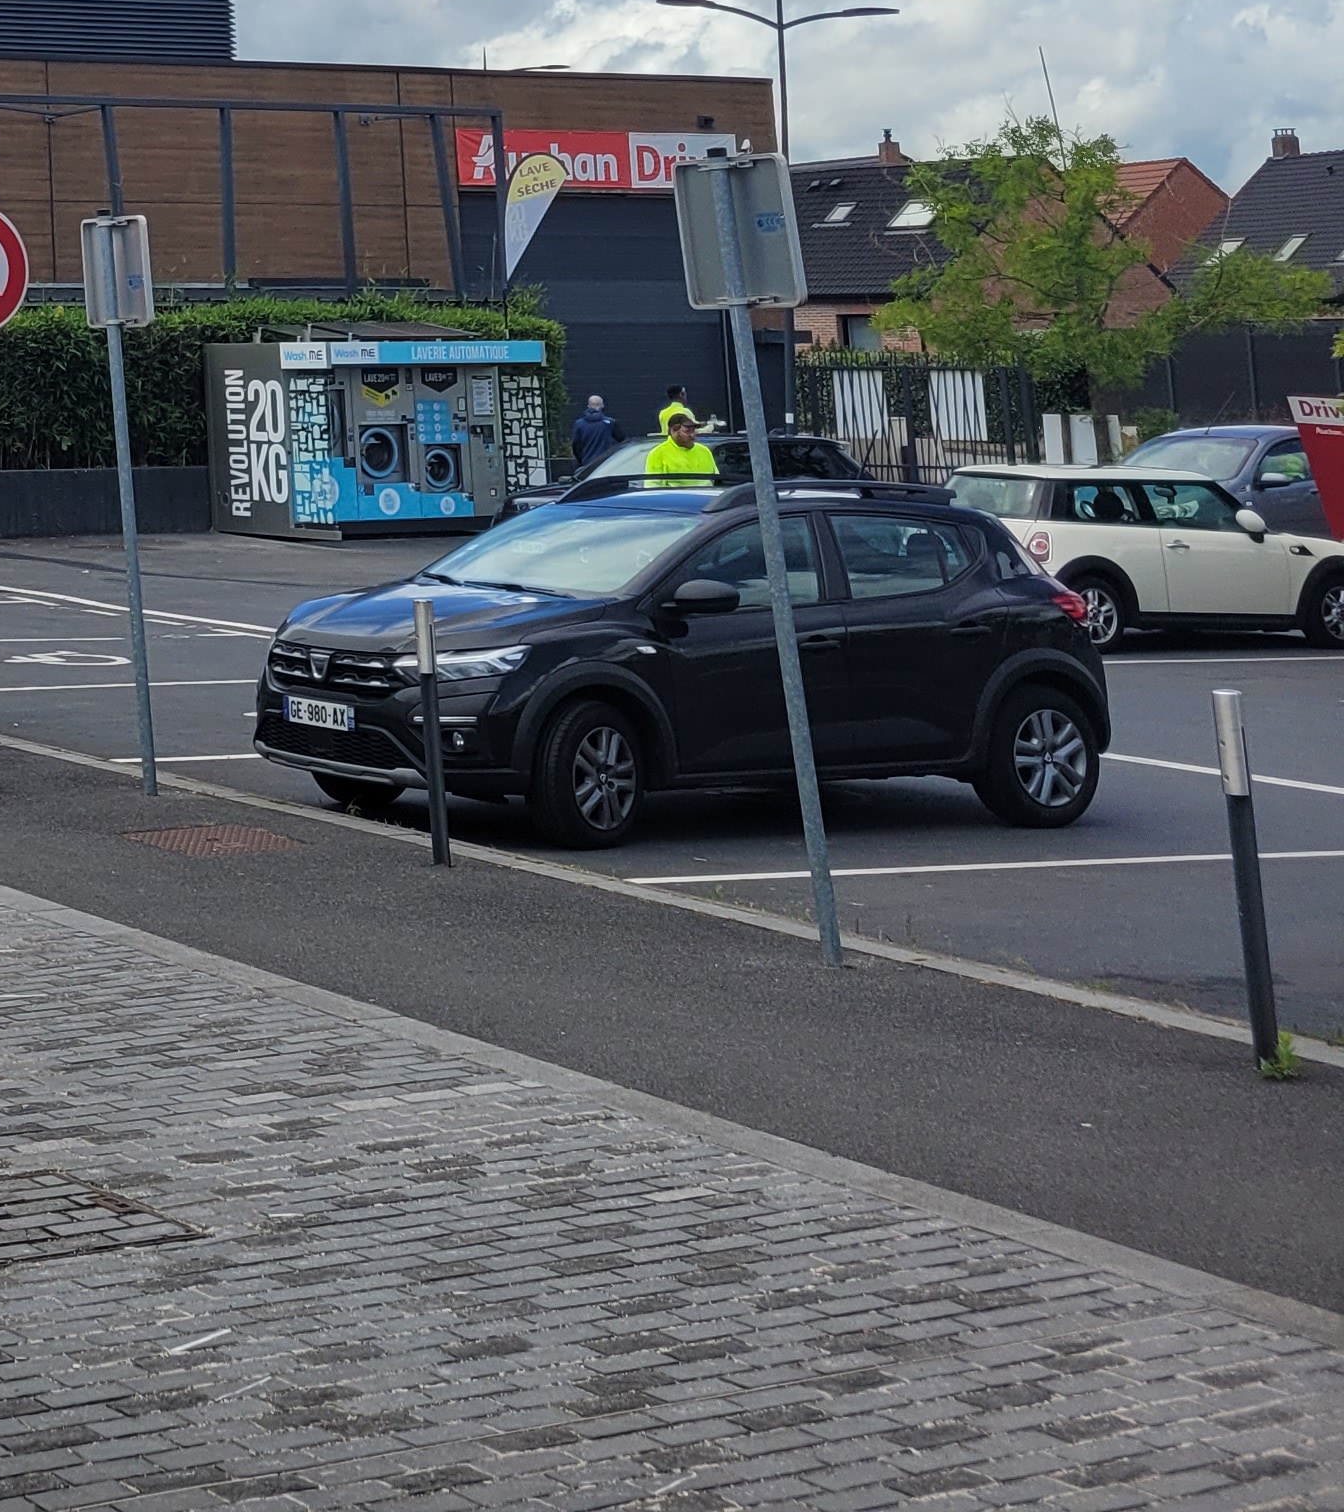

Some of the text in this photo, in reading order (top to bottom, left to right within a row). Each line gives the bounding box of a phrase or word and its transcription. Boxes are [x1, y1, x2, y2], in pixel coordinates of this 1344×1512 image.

[519, 162, 551, 178] LAVE
[516, 178, 558, 197] SÈCHE
[284, 351, 307, 361] Wash
[334, 349, 359, 359] Wash
[412, 346, 510, 360] LAVERIE AUTOMATIQUE
[247, 379, 286, 443] 20
[1298, 399, 1344, 419] Driv
[224, 369, 252, 517] REVOLUTION
[249, 443, 289, 504] KG
[290, 700, 347, 728] GE-980-AX
